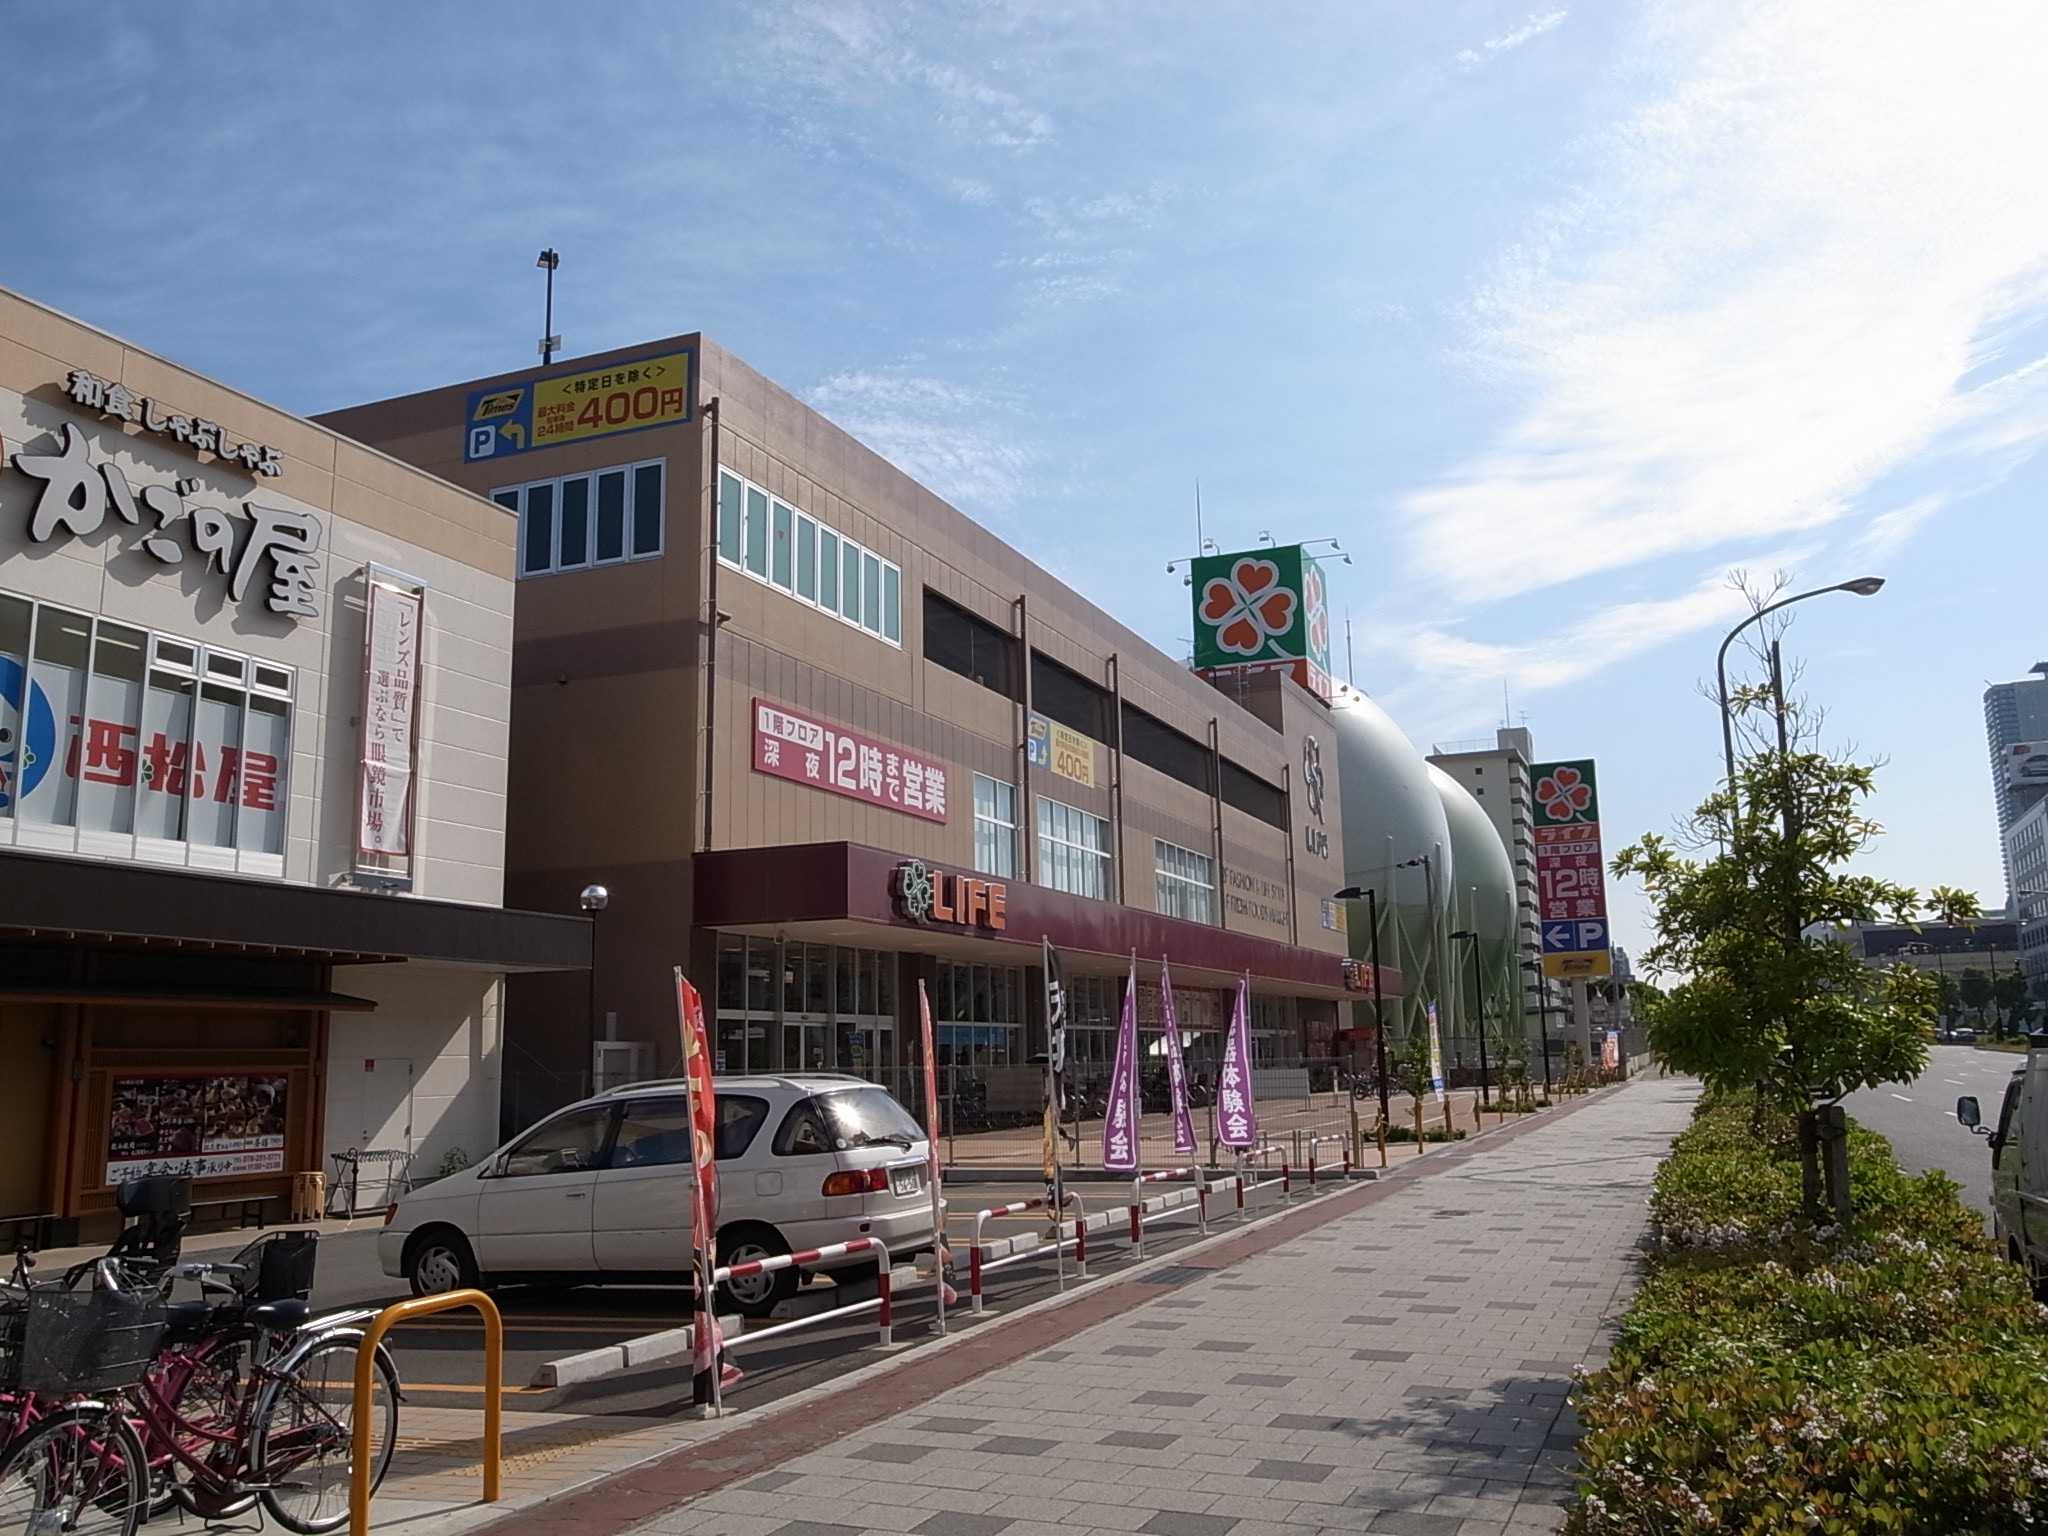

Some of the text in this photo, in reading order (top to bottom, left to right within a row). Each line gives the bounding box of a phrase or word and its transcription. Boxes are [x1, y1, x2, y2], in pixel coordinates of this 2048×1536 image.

[538, 400, 575, 418] 最大料金
[577, 386, 684, 429] 400円
[474, 428, 491, 454] P
[538, 419, 575, 437] 24時間
[10, 422, 324, 617] かごの屋
[764, 711, 819, 745] 1階フロア
[65, 715, 277, 811] 西松屋
[1057, 750, 1089, 785] 400円
[1540, 825, 1593, 841] ライフ
[933, 869, 1006, 930] LIFE
[1548, 898, 1597, 919] 営業
[1579, 922, 1604, 948] P
